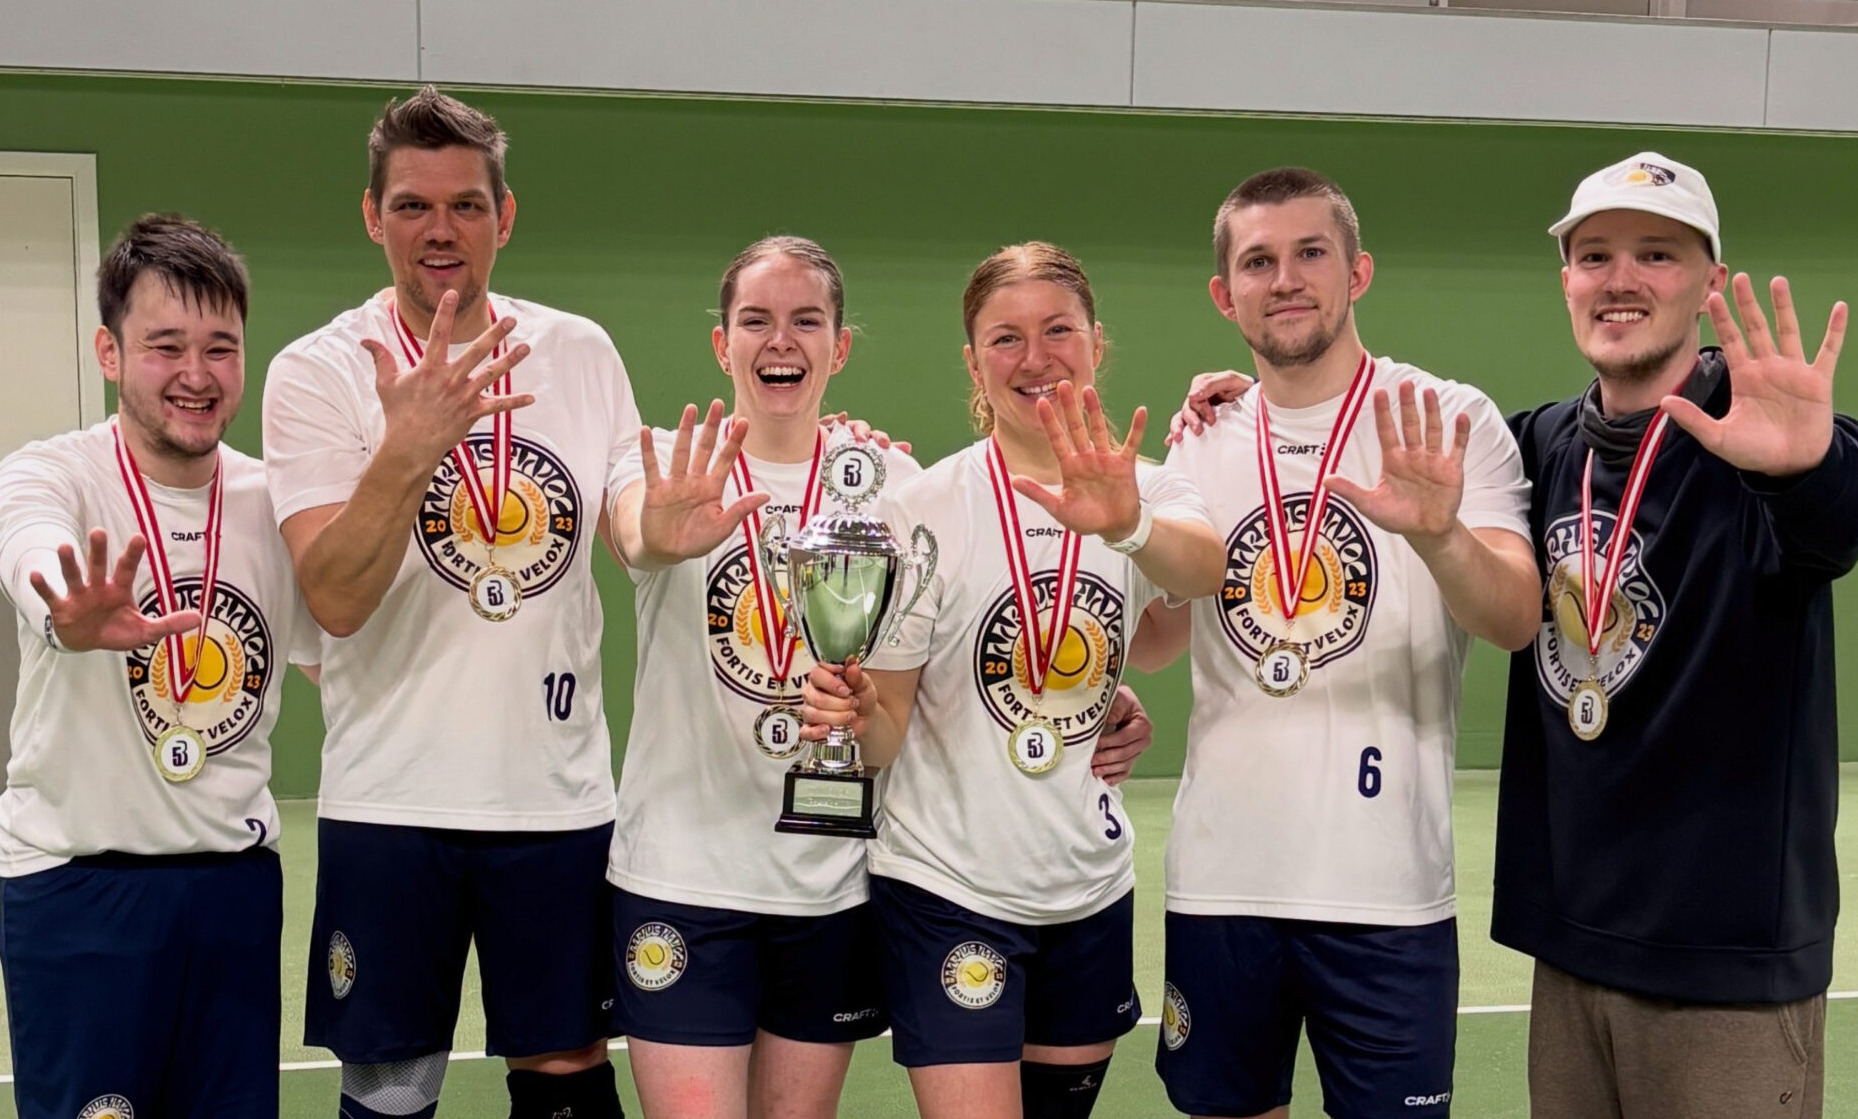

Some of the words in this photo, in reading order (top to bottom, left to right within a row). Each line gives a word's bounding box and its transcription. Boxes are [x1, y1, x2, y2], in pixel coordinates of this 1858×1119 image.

[1277, 444, 1320, 455] CRAFT
[425, 519, 446, 533] 20
[555, 517, 573, 531] 23
[519, 538, 565, 582] VELOX
[1224, 586, 1246, 599] 20
[1348, 582, 1367, 597] 23
[708, 613, 728, 628] 20
[1313, 605, 1359, 650] VELOX
[1636, 623, 1655, 642] 23
[716, 636, 764, 686] FORTIS
[985, 661, 1007, 675] 20
[246, 675, 261, 689] 23
[543, 671, 576, 722] 10
[1075, 680, 1111, 726] VELOX
[207, 695, 253, 740] VELOX
[1358, 745, 1383, 799] 6
[1098, 792, 1122, 840] 3
[832, 1007, 873, 1022] CRAFT
[1404, 1092, 1448, 1106] CRAFT
